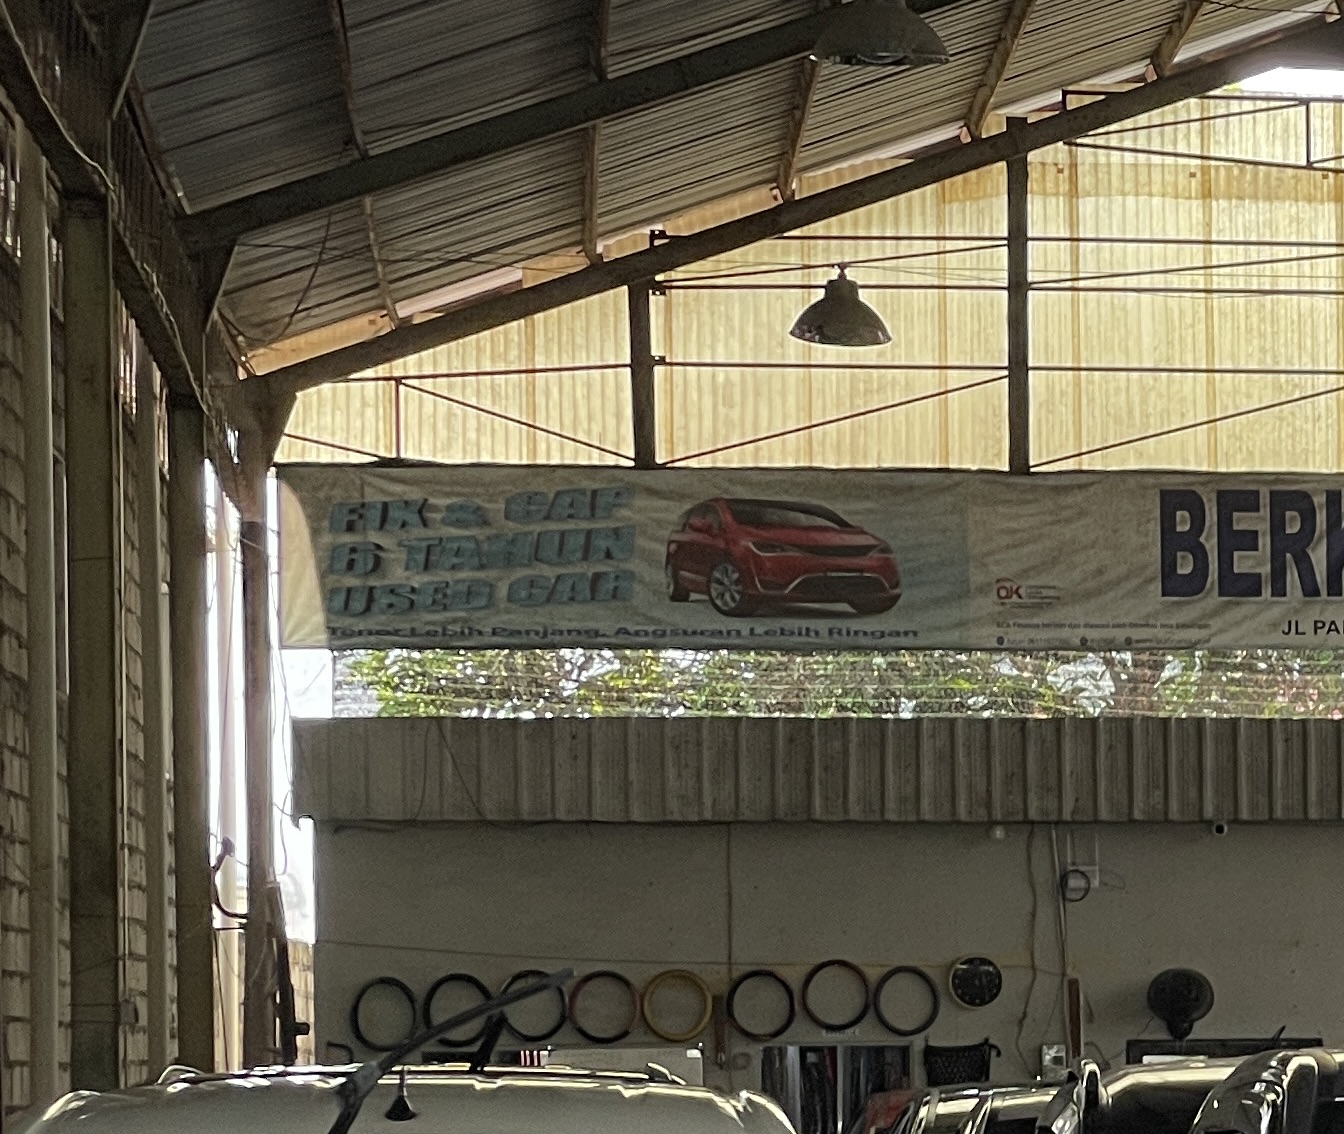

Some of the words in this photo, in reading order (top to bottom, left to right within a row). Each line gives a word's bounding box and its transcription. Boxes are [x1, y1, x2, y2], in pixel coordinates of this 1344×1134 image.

[329, 498, 428, 532] FIX
[398, 525, 636, 571] TAHUN
[328, 579, 494, 616] USED
[507, 570, 636, 607] CAR
[408, 625, 483, 637] Lebih
[614, 626, 742, 639] Angsuran
[750, 626, 820, 637] Lebih
[828, 626, 919, 640] Ringan
[1282, 619, 1306, 636] JL
